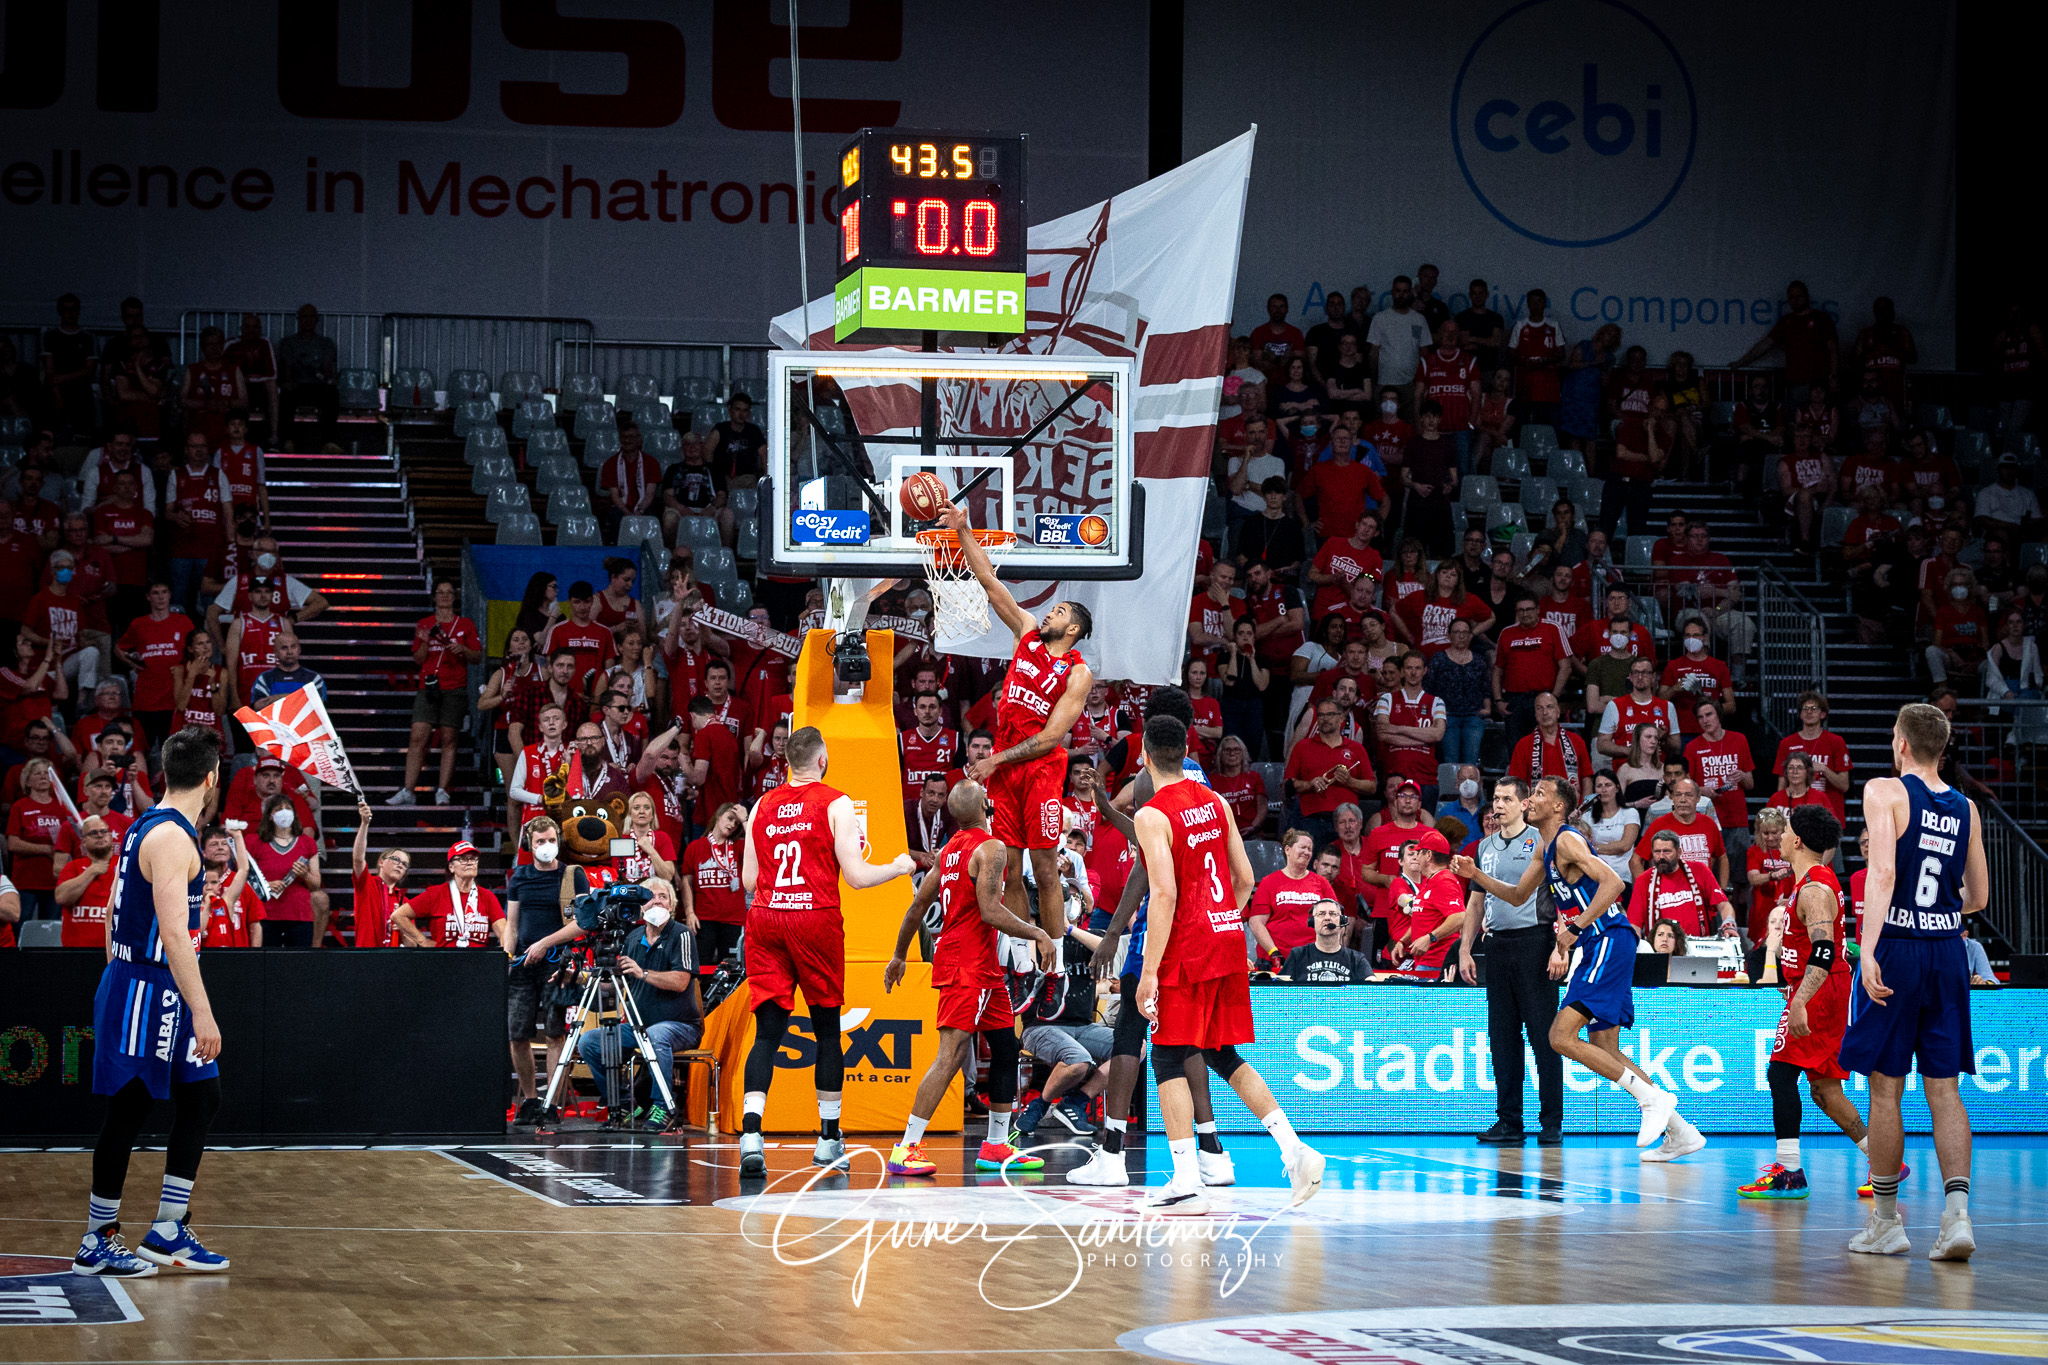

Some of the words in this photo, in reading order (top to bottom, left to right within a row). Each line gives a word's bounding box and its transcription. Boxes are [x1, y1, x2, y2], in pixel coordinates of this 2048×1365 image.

[1474, 63, 1661, 157] cebi
[891, 143, 973, 179] 43.5
[306, 157, 365, 213] in
[868, 285, 1019, 315] BARMER
[1570, 286, 1839, 332] Compones
[922, 474, 943, 507] SPALDING
[190, 509, 217, 521] ose
[1039, 530, 1071, 543] BBL
[1202, 608, 1224, 624] ROT
[1277, 602, 1287, 616] 8
[1203, 624, 1224, 638] WAN
[1040, 672, 1058, 695] 11
[1008, 681, 1051, 716] brose
[1417, 718, 1431, 728] 10
[936, 748, 951, 762] 21
[1701, 753, 1735, 767] POKAL
[37, 817, 61, 827] BAM
[1920, 808, 1961, 836] DELON
[773, 840, 806, 888] 22
[1203, 851, 1224, 904] 3
[1914, 855, 1943, 908] 6
[772, 890, 813, 902] brose
[71, 905, 108, 919] bros
[1207, 909, 1242, 924] brose
[1815, 946, 1831, 960] 12
[1064, 962, 1092, 976] RTH
[1306, 960, 1323, 971] TOM
[1324, 960, 1351, 974] TAILOR
[155, 1011, 176, 1062] ALBA
[773, 1014, 923, 1070] SXT
[869, 1074, 878, 1083] a
[883, 1073, 911, 1083] car
